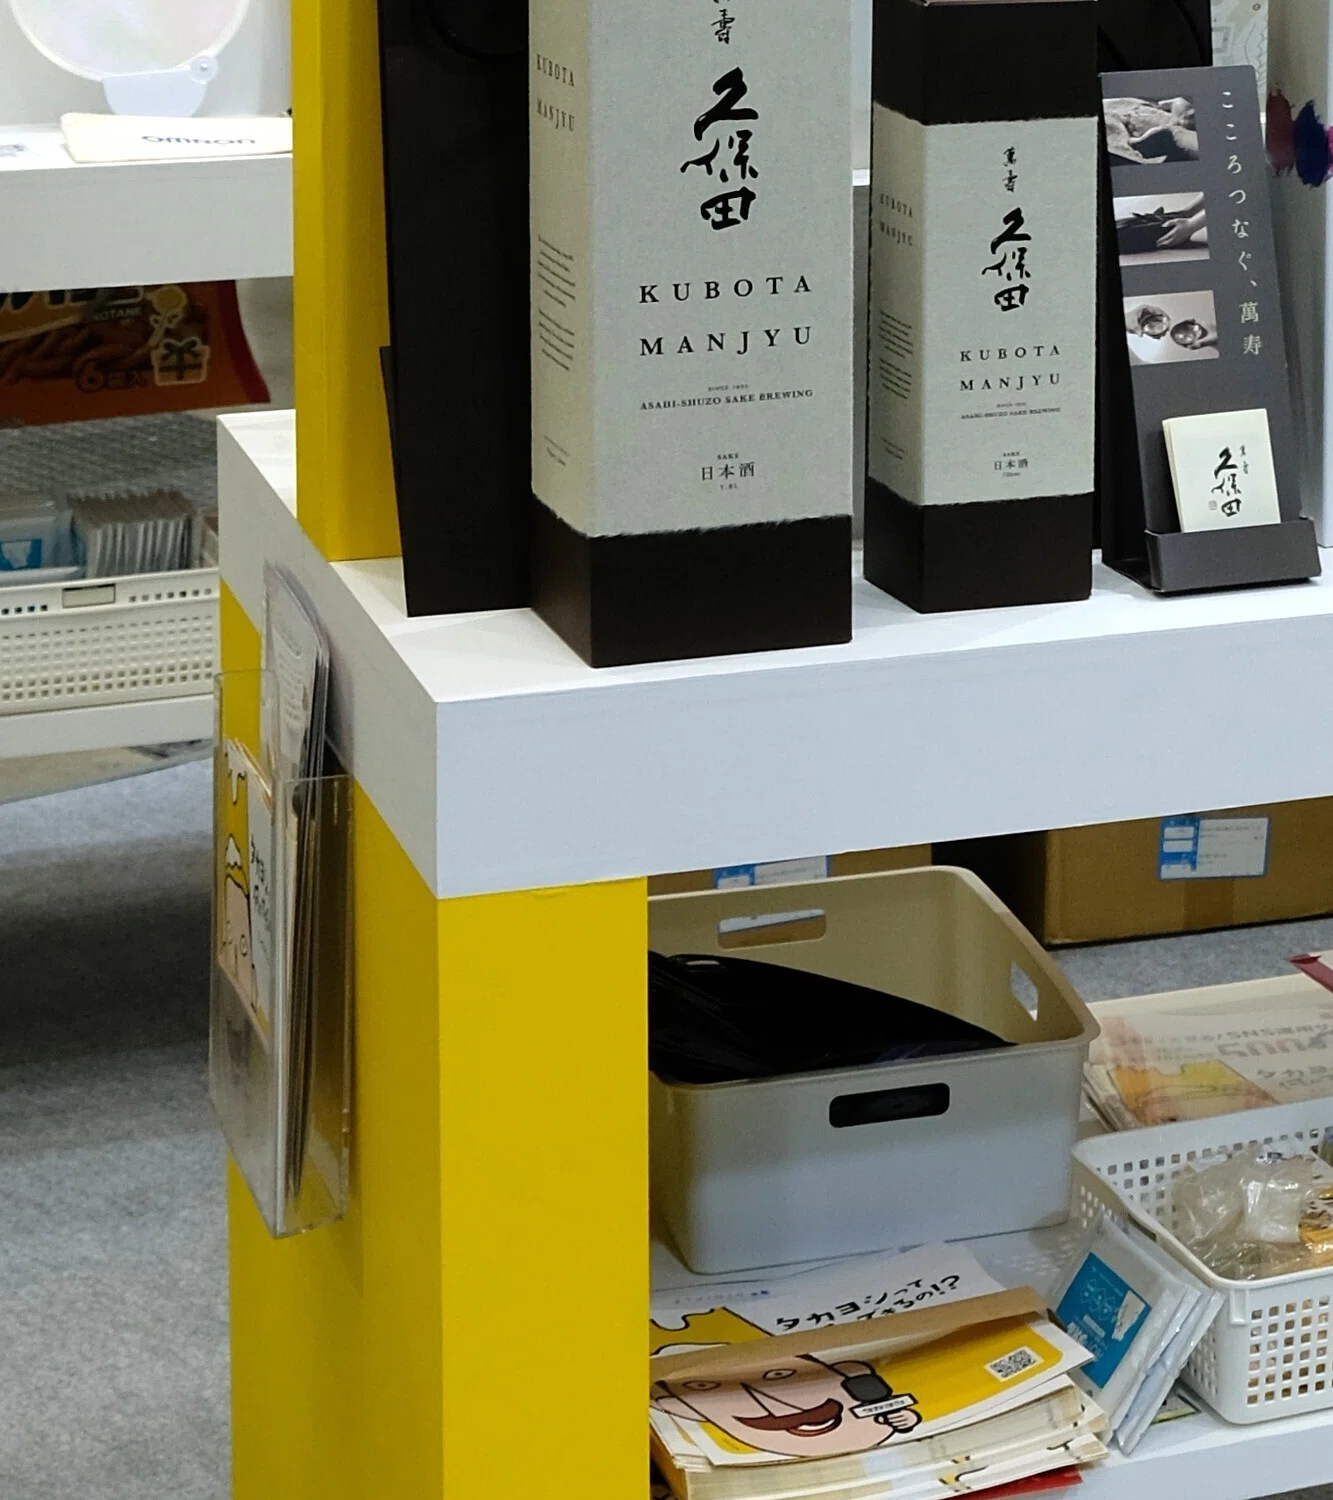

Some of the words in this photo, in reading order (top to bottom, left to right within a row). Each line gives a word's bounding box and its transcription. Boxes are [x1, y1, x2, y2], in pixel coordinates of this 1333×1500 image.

[535, 52, 576, 89] KUBOTA
[535, 96, 576, 134] MANJYU
[680, 66, 760, 231] 久保田
[981, 206, 1032, 312] 久保田
[640, 274, 813, 305] KUBOTA
[640, 326, 813, 357] MANJYU
[960, 345, 1061, 363] KUBOTA
[960, 373, 1061, 392] MANJYU
[640, 396, 721, 411] ASAHI-SHUZO
[724, 393, 757, 406] SAKE
[758, 388, 814, 403] BREWING
[701, 461, 756, 482] 日本酒
[993, 458, 1030, 472] 日本酒
[1210, 445, 1242, 518] 久保田
